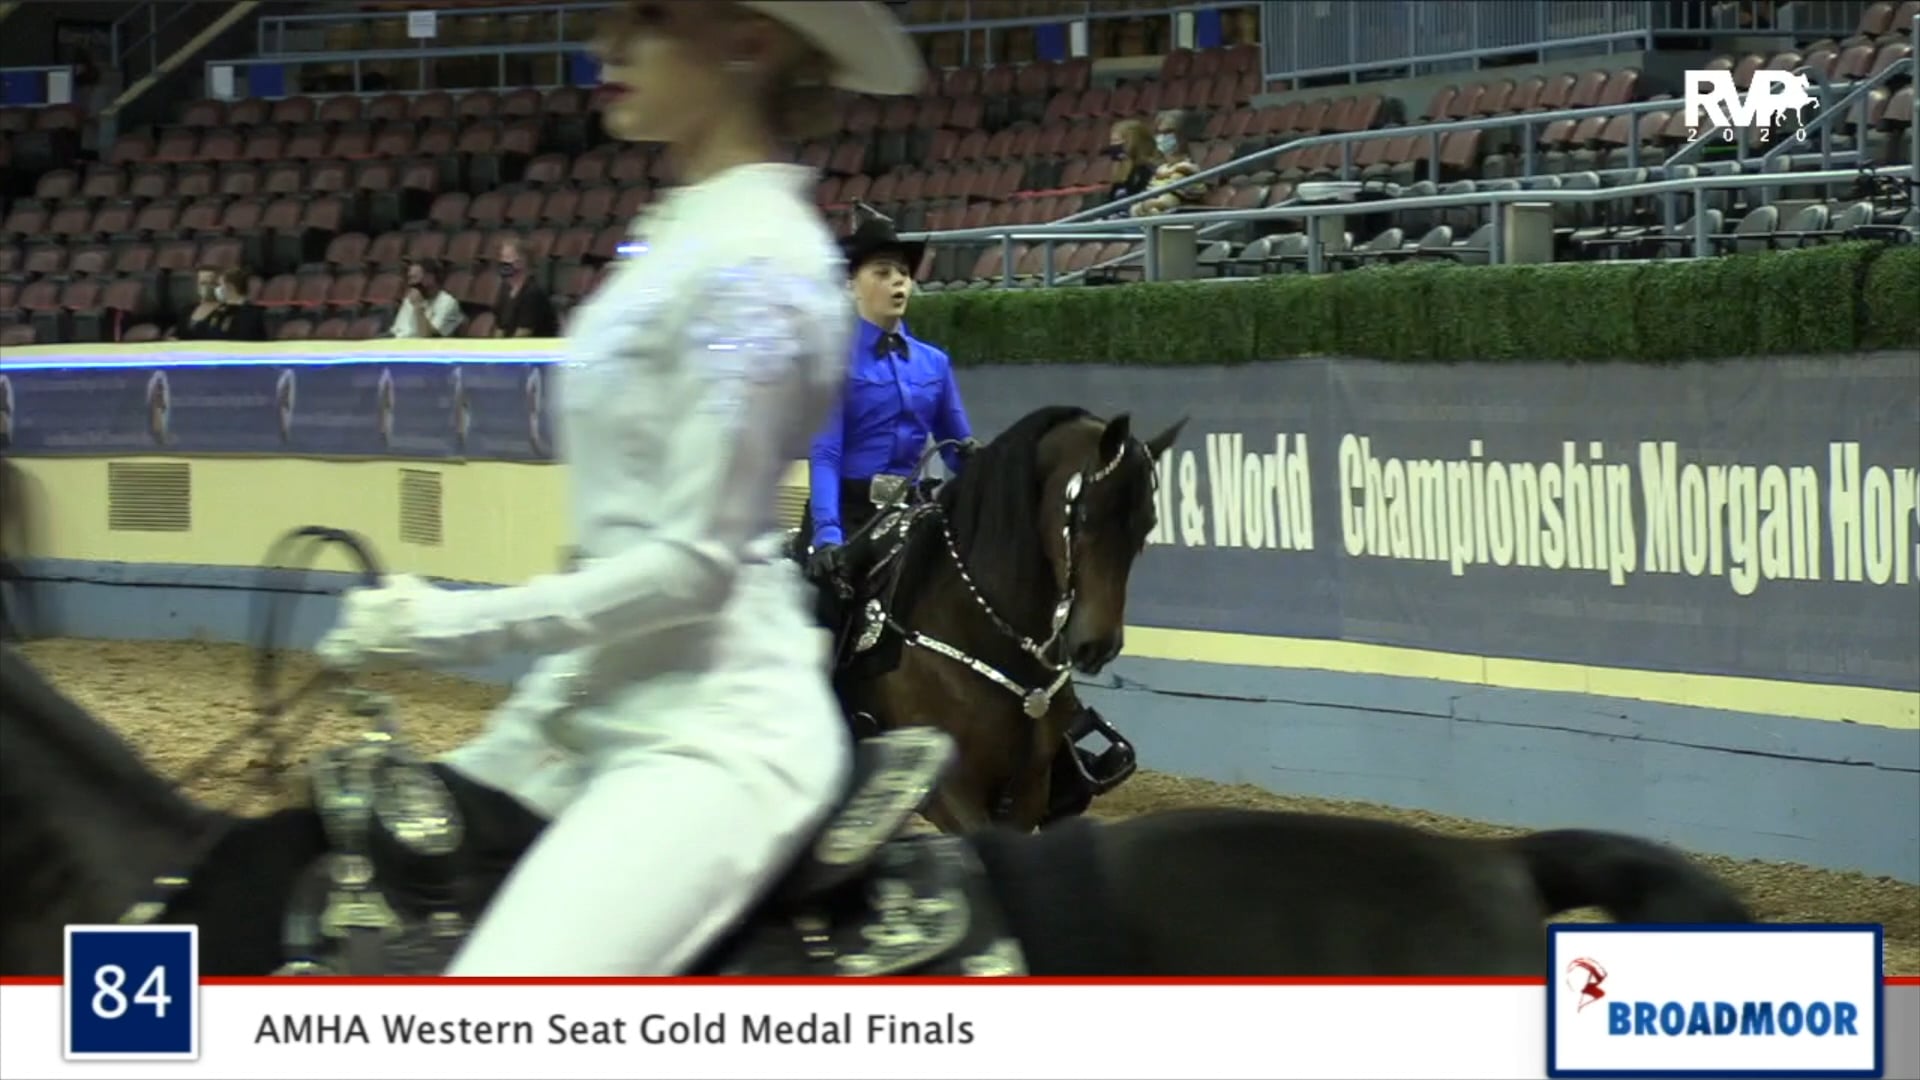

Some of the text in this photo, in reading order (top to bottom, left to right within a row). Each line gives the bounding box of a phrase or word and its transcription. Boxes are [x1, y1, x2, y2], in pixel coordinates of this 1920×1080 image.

[1179, 450, 1206, 547] &
[1205, 432, 1314, 551] World
[1338, 433, 1637, 586] Championship
[1639, 441, 1821, 596] Morgan
[1829, 442, 1920, 585] Hor
